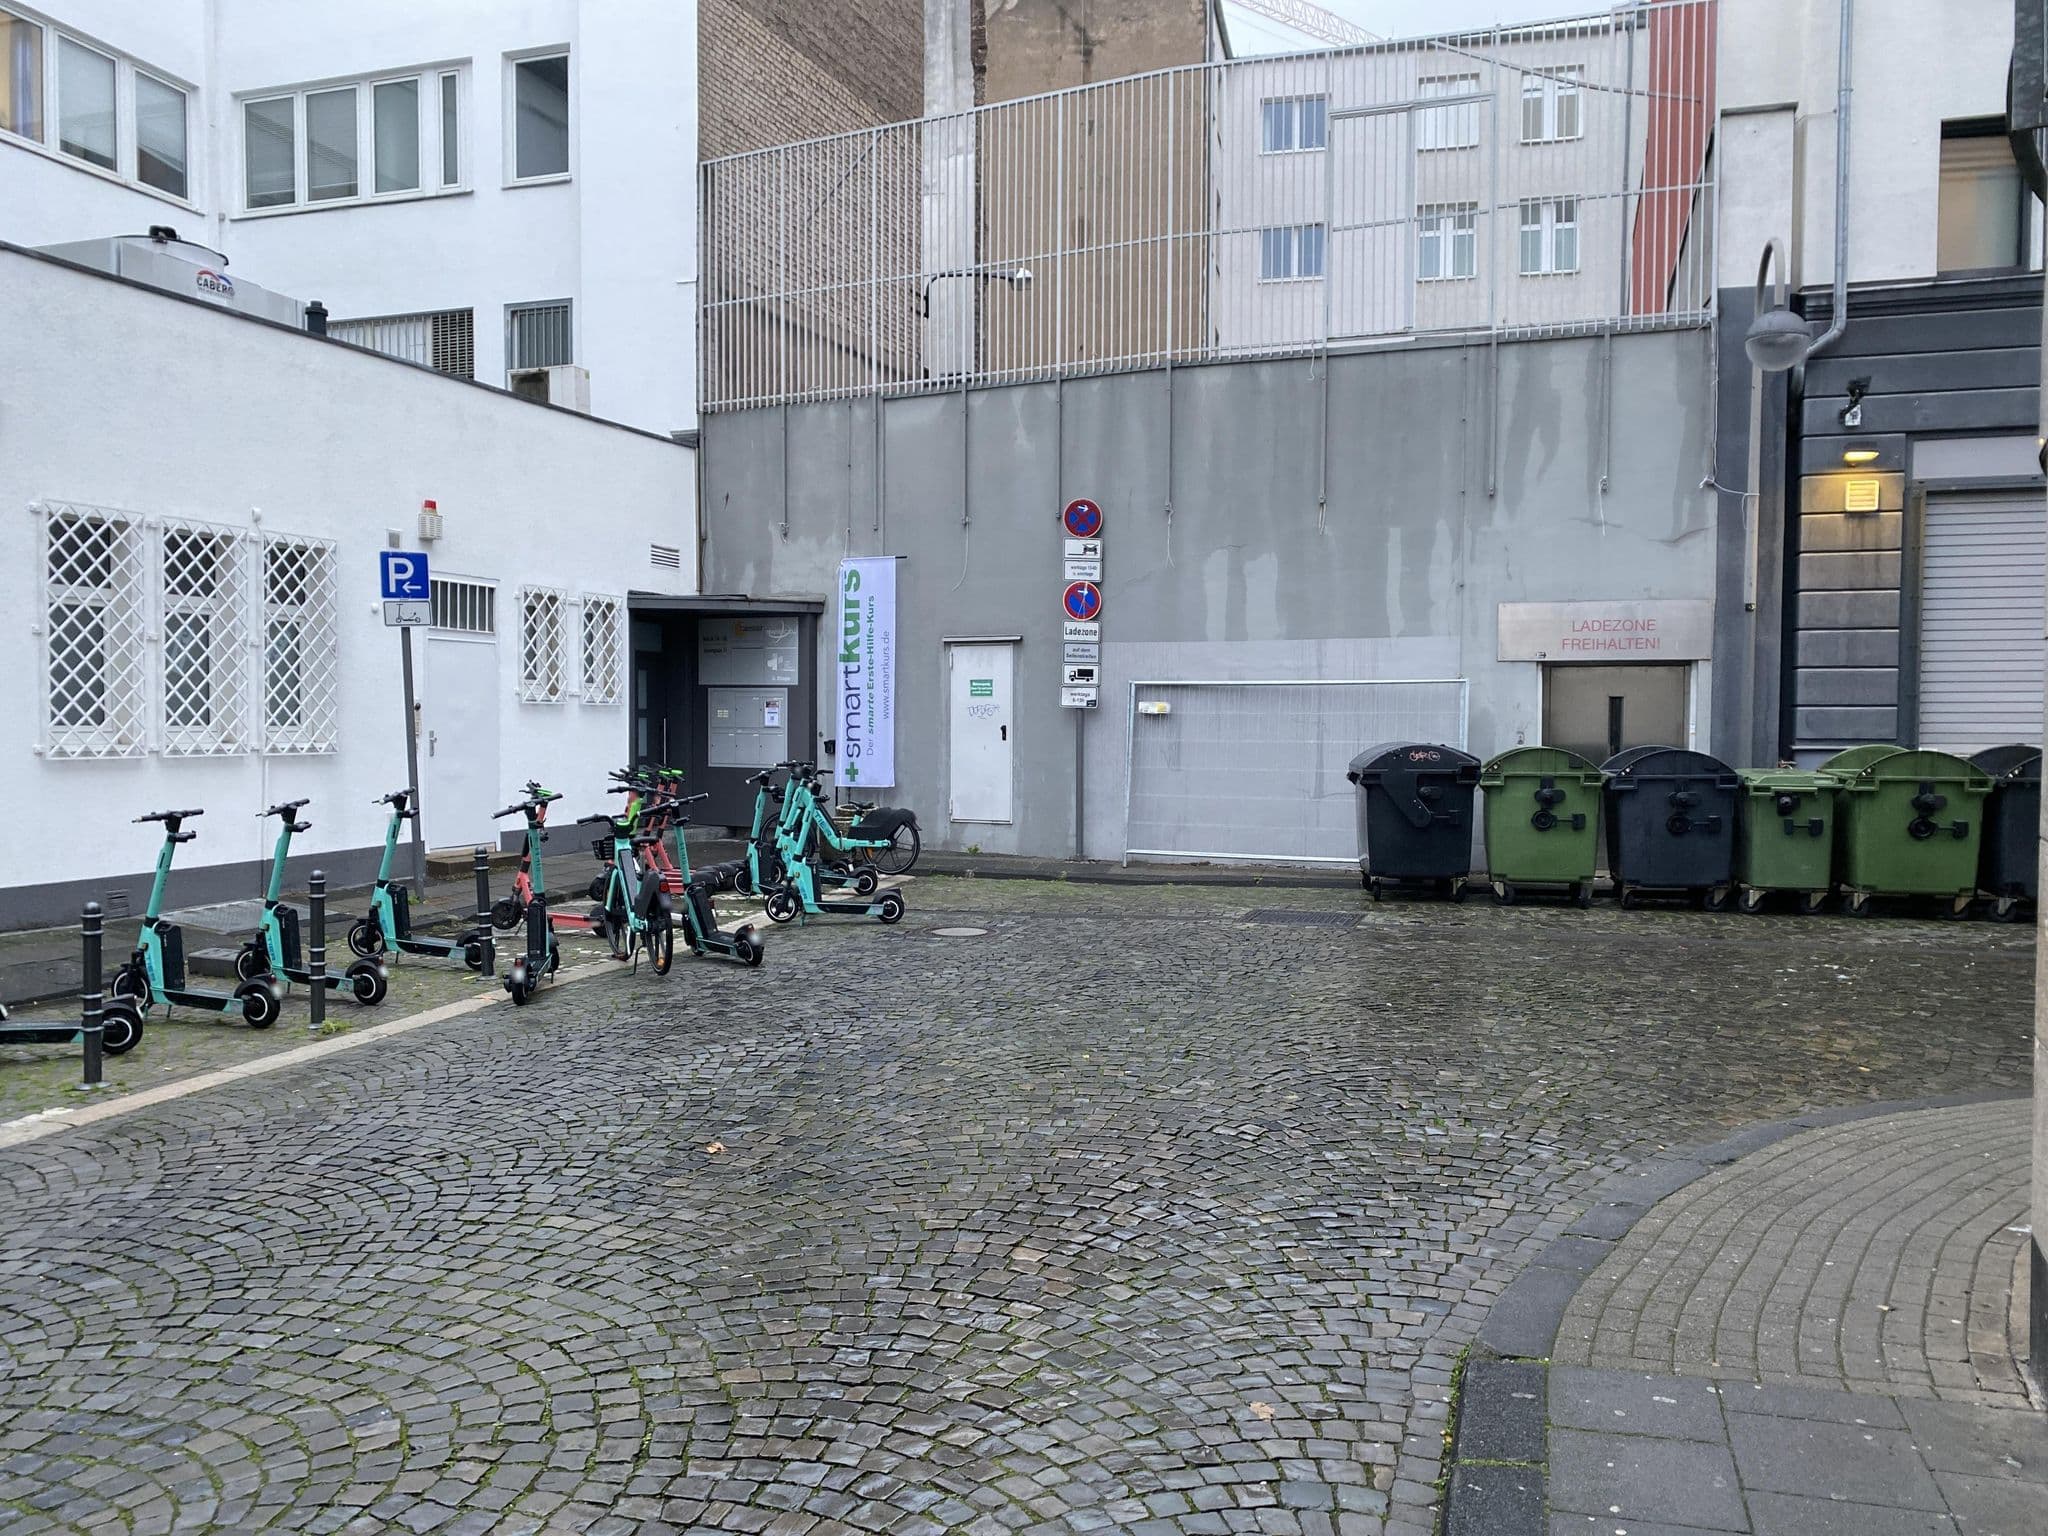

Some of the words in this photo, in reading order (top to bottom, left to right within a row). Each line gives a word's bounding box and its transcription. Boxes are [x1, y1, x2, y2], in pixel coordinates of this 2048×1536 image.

[388, 557, 415, 593] P
[1064, 626, 1098, 636] Ladezone
[1572, 619, 1656, 632] LADEZONE
[866, 595, 875, 690] Erste-Hilfe-Kurs
[1562, 637, 1660, 650] FREIHALTEN!
[839, 568, 861, 758] smartkurs
[866, 692, 875, 734] smarte
[866, 738, 874, 756] Der
